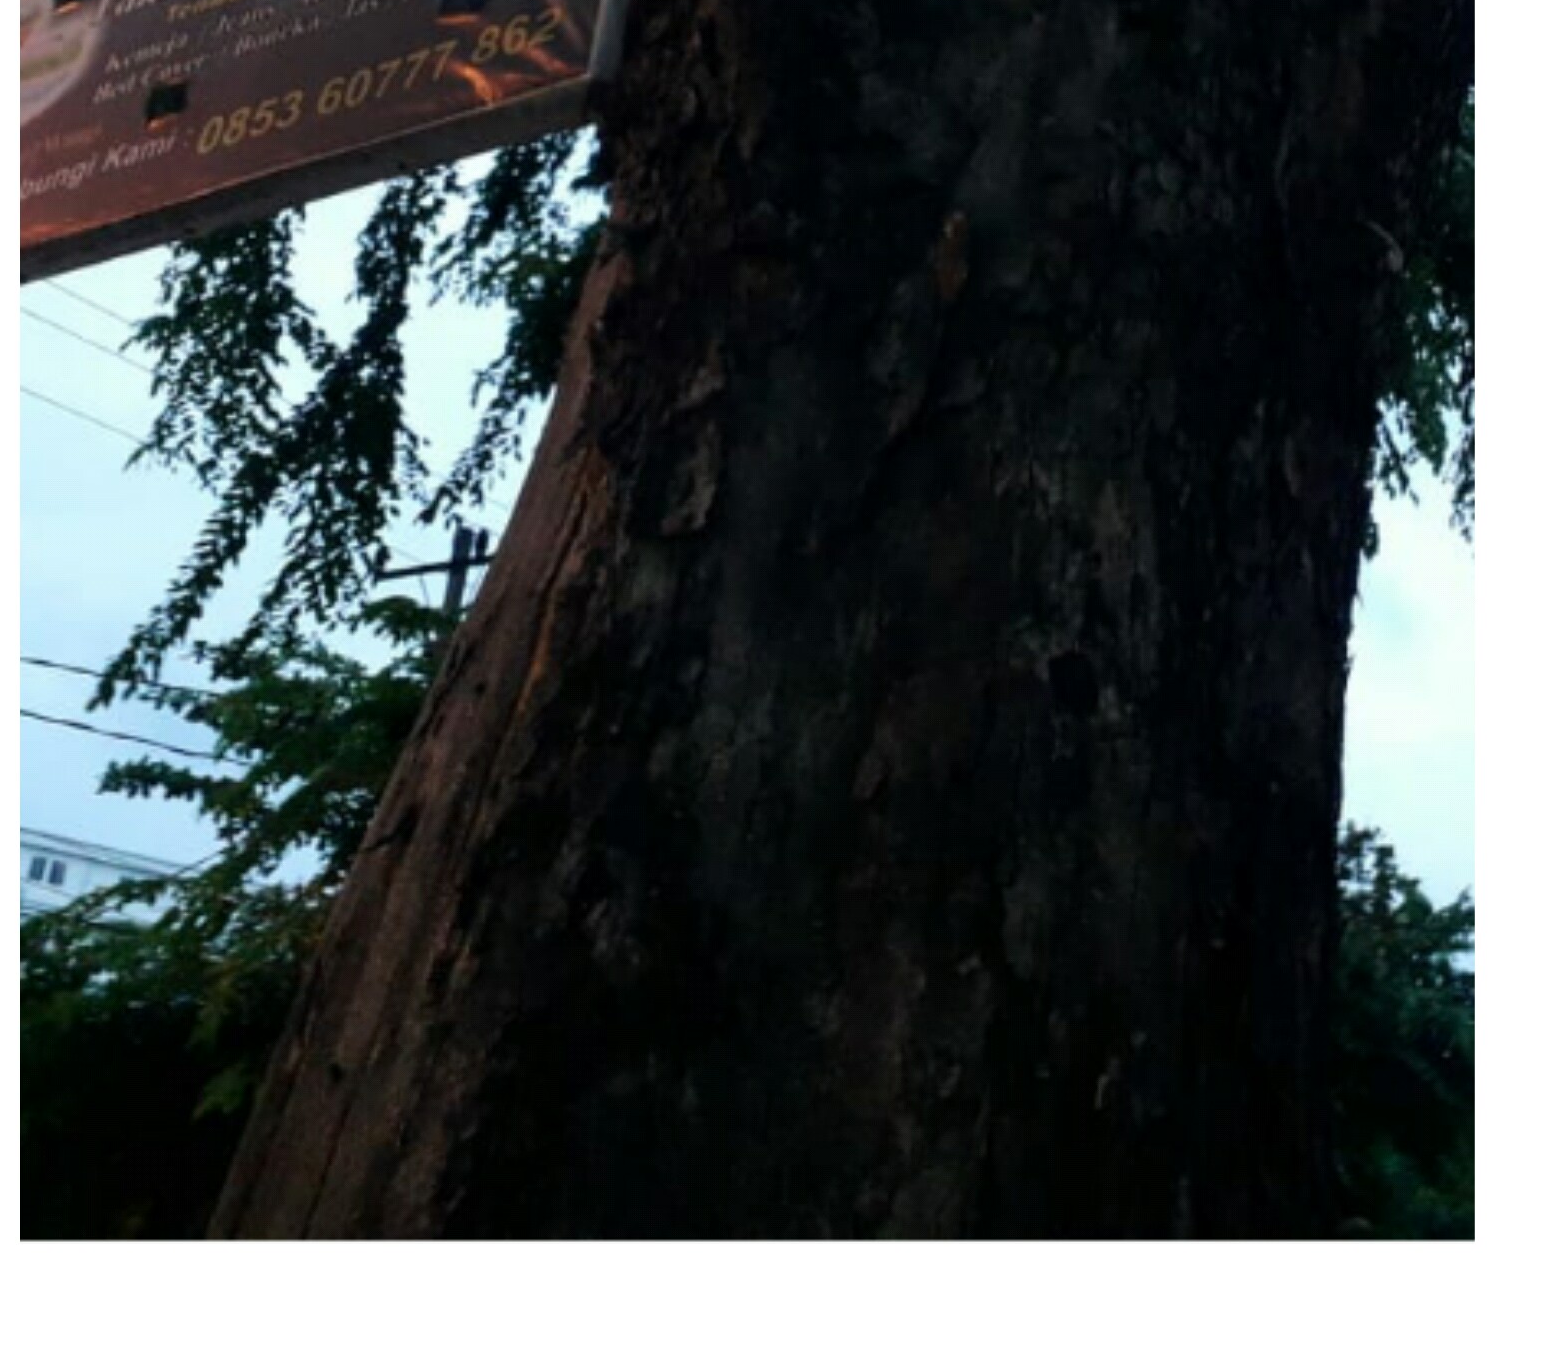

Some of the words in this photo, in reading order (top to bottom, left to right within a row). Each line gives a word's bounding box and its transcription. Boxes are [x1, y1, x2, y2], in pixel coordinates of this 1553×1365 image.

[197, 87, 305, 157] 0853
[316, 39, 459, 117] 60777
[470, 6, 566, 65] 862
